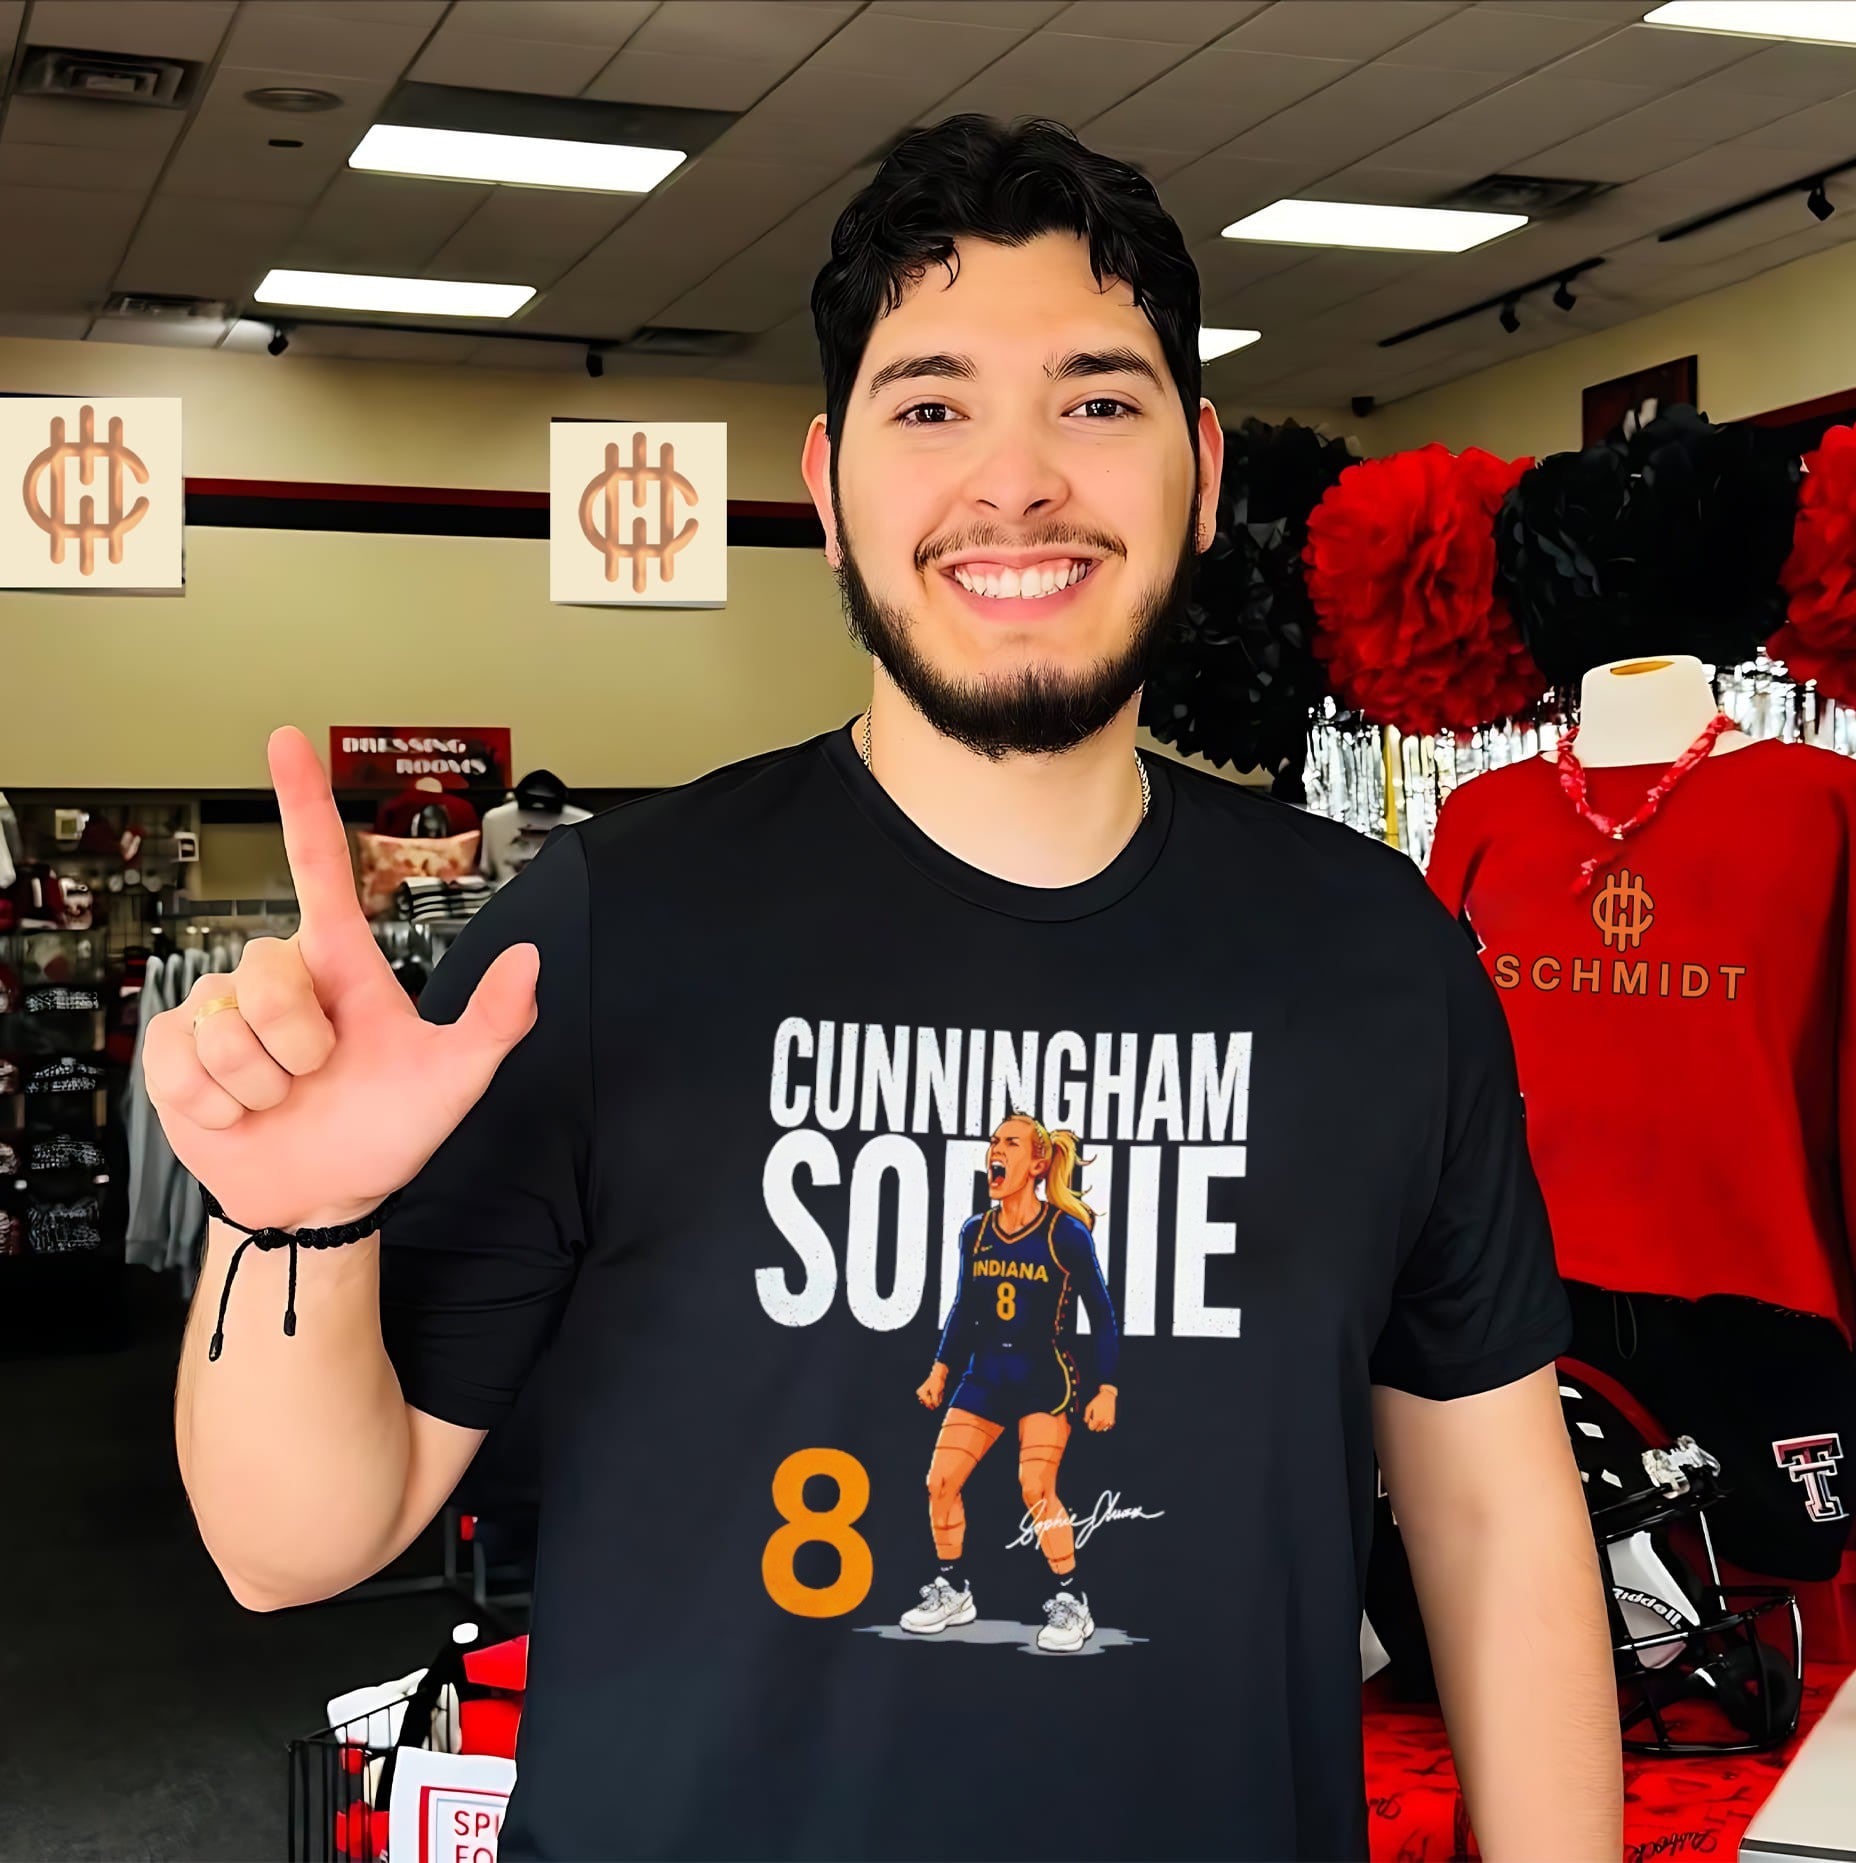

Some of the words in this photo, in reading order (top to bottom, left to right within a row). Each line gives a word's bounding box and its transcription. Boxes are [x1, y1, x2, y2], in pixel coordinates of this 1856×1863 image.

[341, 737, 467, 754] DRESSING
[396, 758, 487, 775] ROOMS
[1494, 953, 1747, 1000] SCHMIDT
[769, 1016, 1253, 1141] CUNNINGHAM
[973, 1259, 1049, 1283] INDIANA
[996, 1281, 1016, 1321] 8
[762, 1447, 873, 1619] 8
